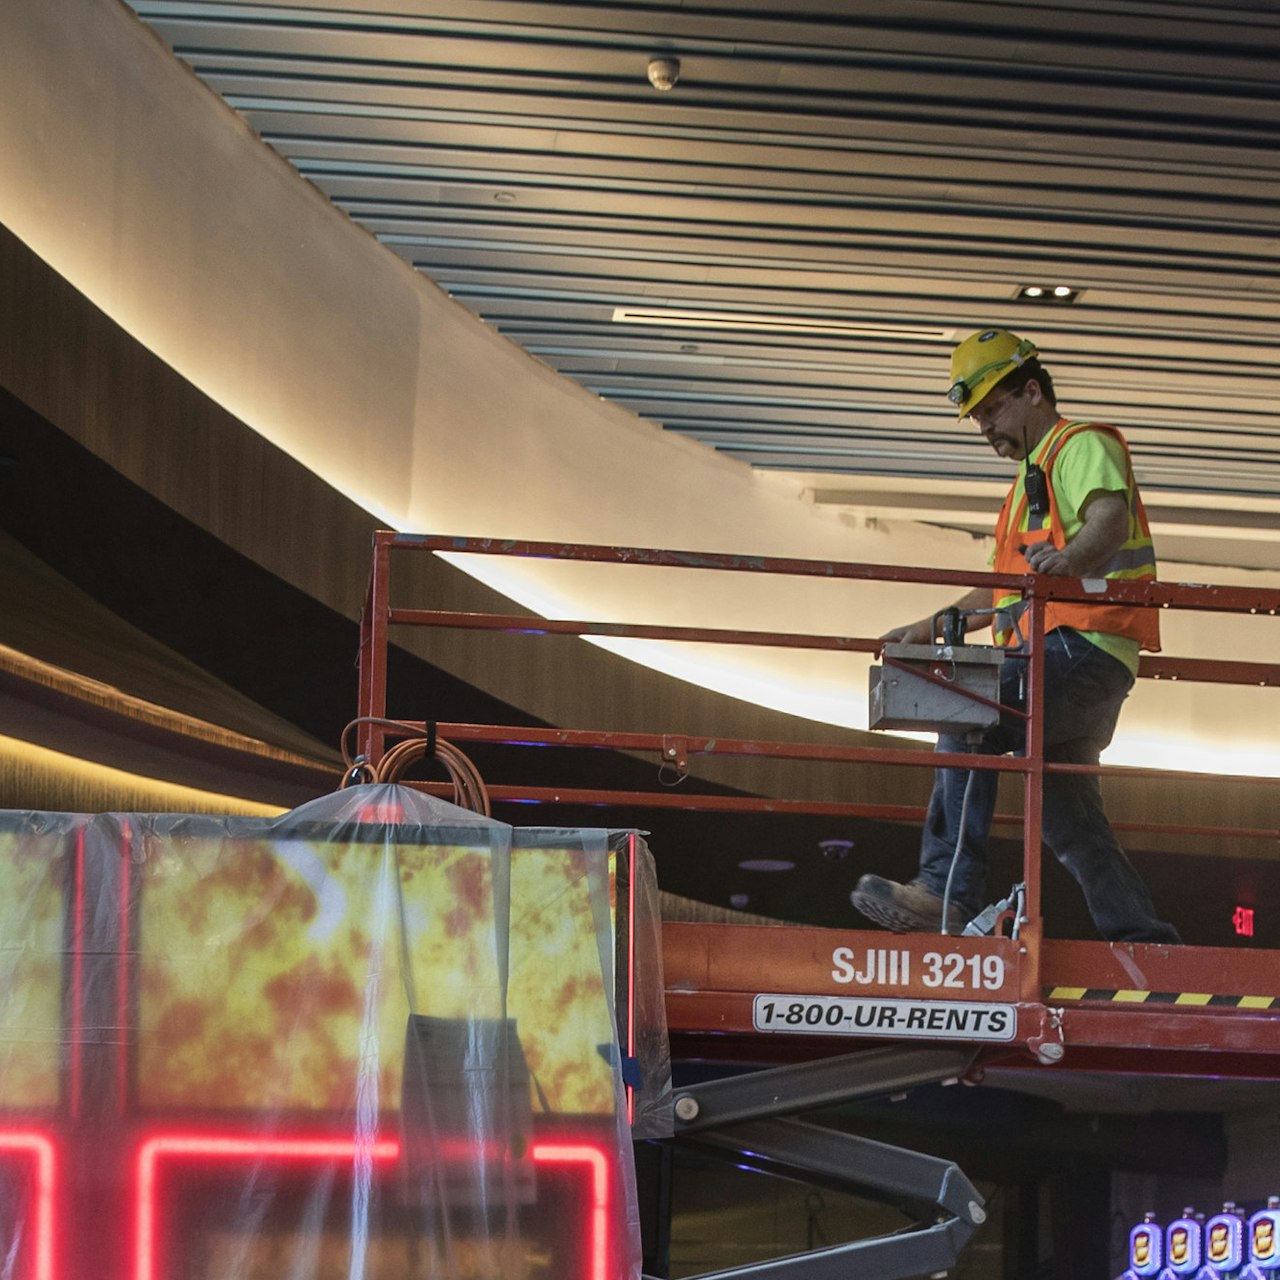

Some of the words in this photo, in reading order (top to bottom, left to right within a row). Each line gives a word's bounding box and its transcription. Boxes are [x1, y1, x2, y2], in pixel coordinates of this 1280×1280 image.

[832, 947, 910, 985] SJIII
[922, 952, 1005, 990] 3219
[762, 1002, 1008, 1032] 1-800-UR-RENTS
